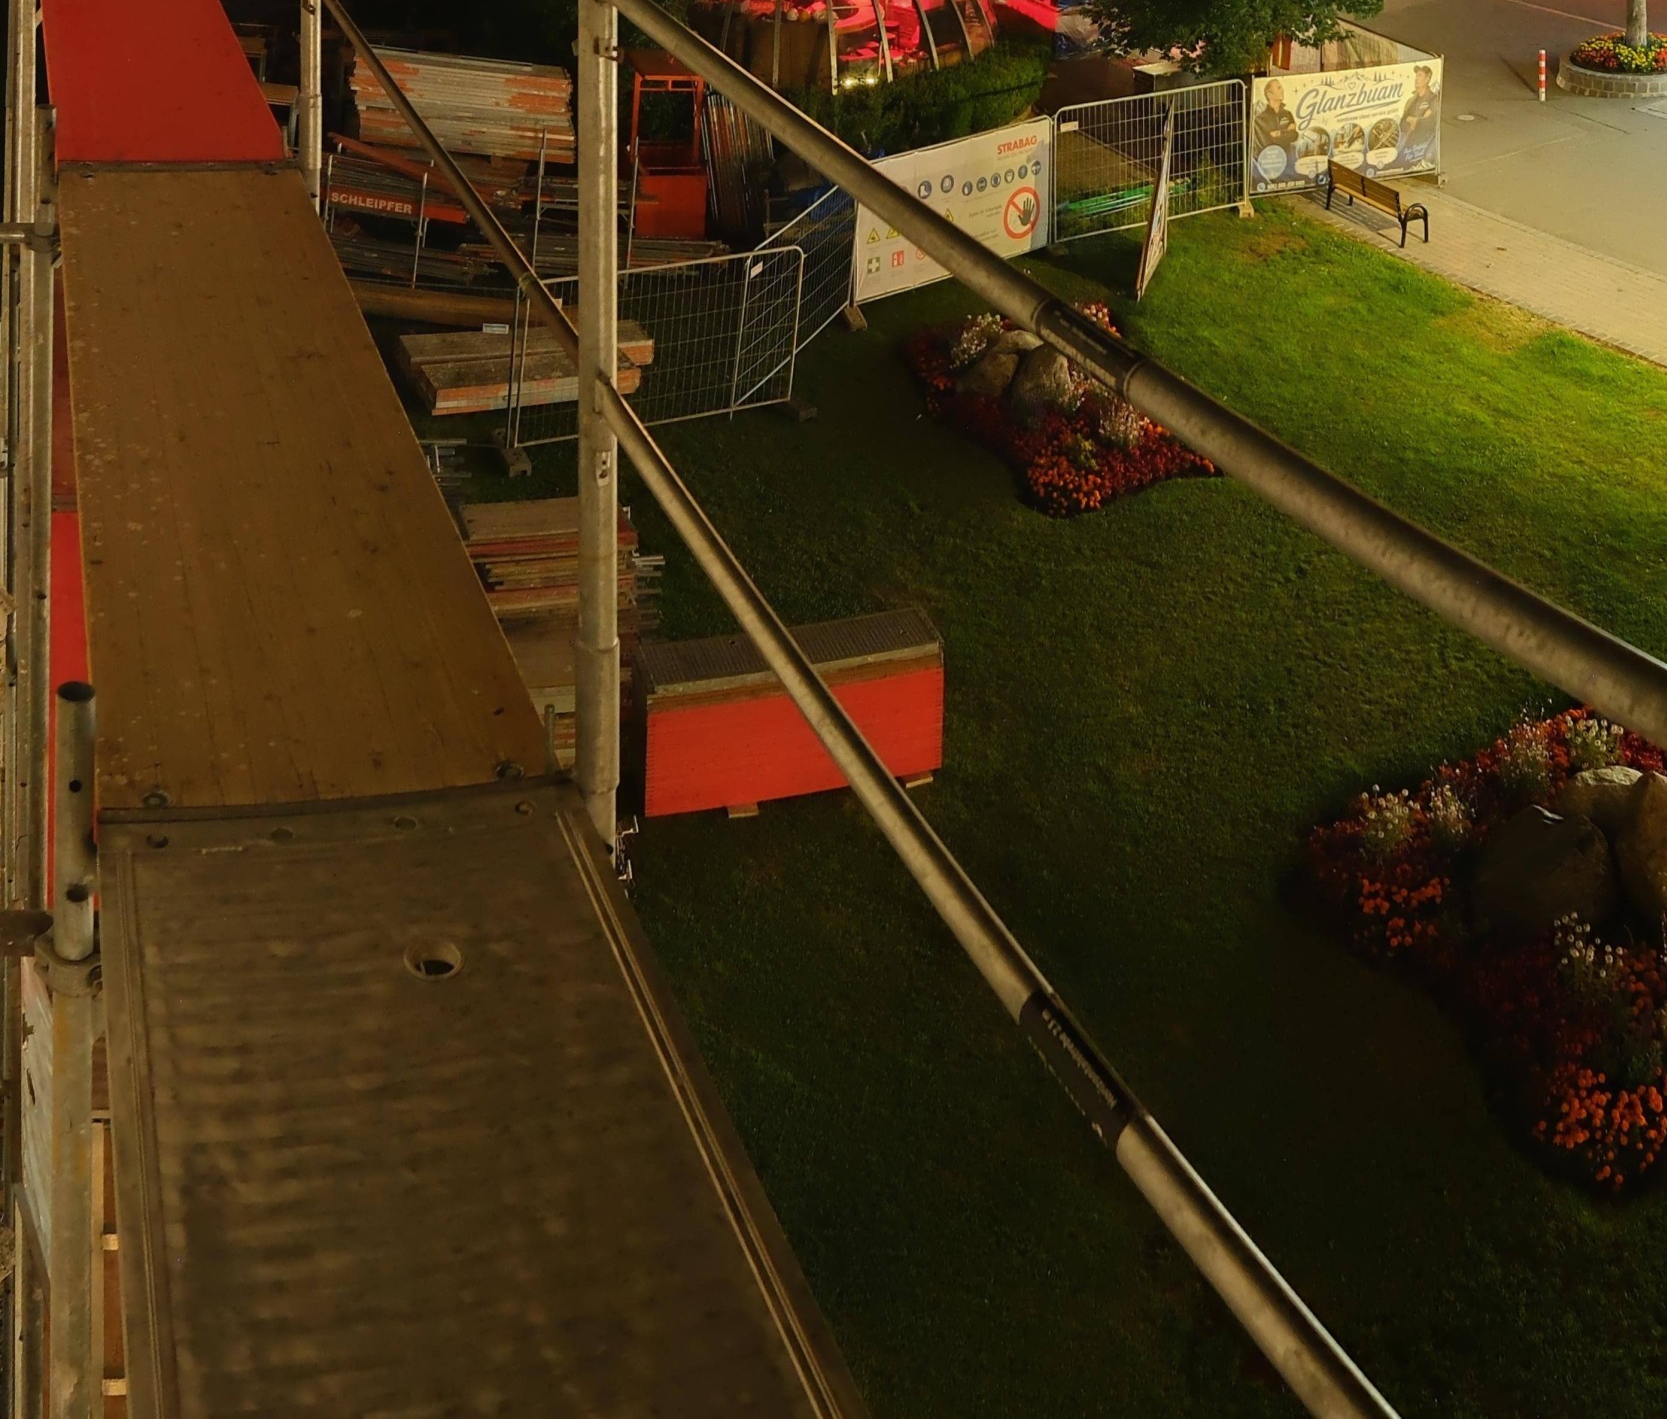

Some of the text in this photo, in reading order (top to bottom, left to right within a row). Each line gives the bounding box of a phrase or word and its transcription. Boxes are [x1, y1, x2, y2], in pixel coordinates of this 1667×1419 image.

[1295, 81, 1403, 131] Glanzbuam
[997, 135, 1038, 155] STRABAG
[330, 192, 413, 216] SCHLEIPFER
